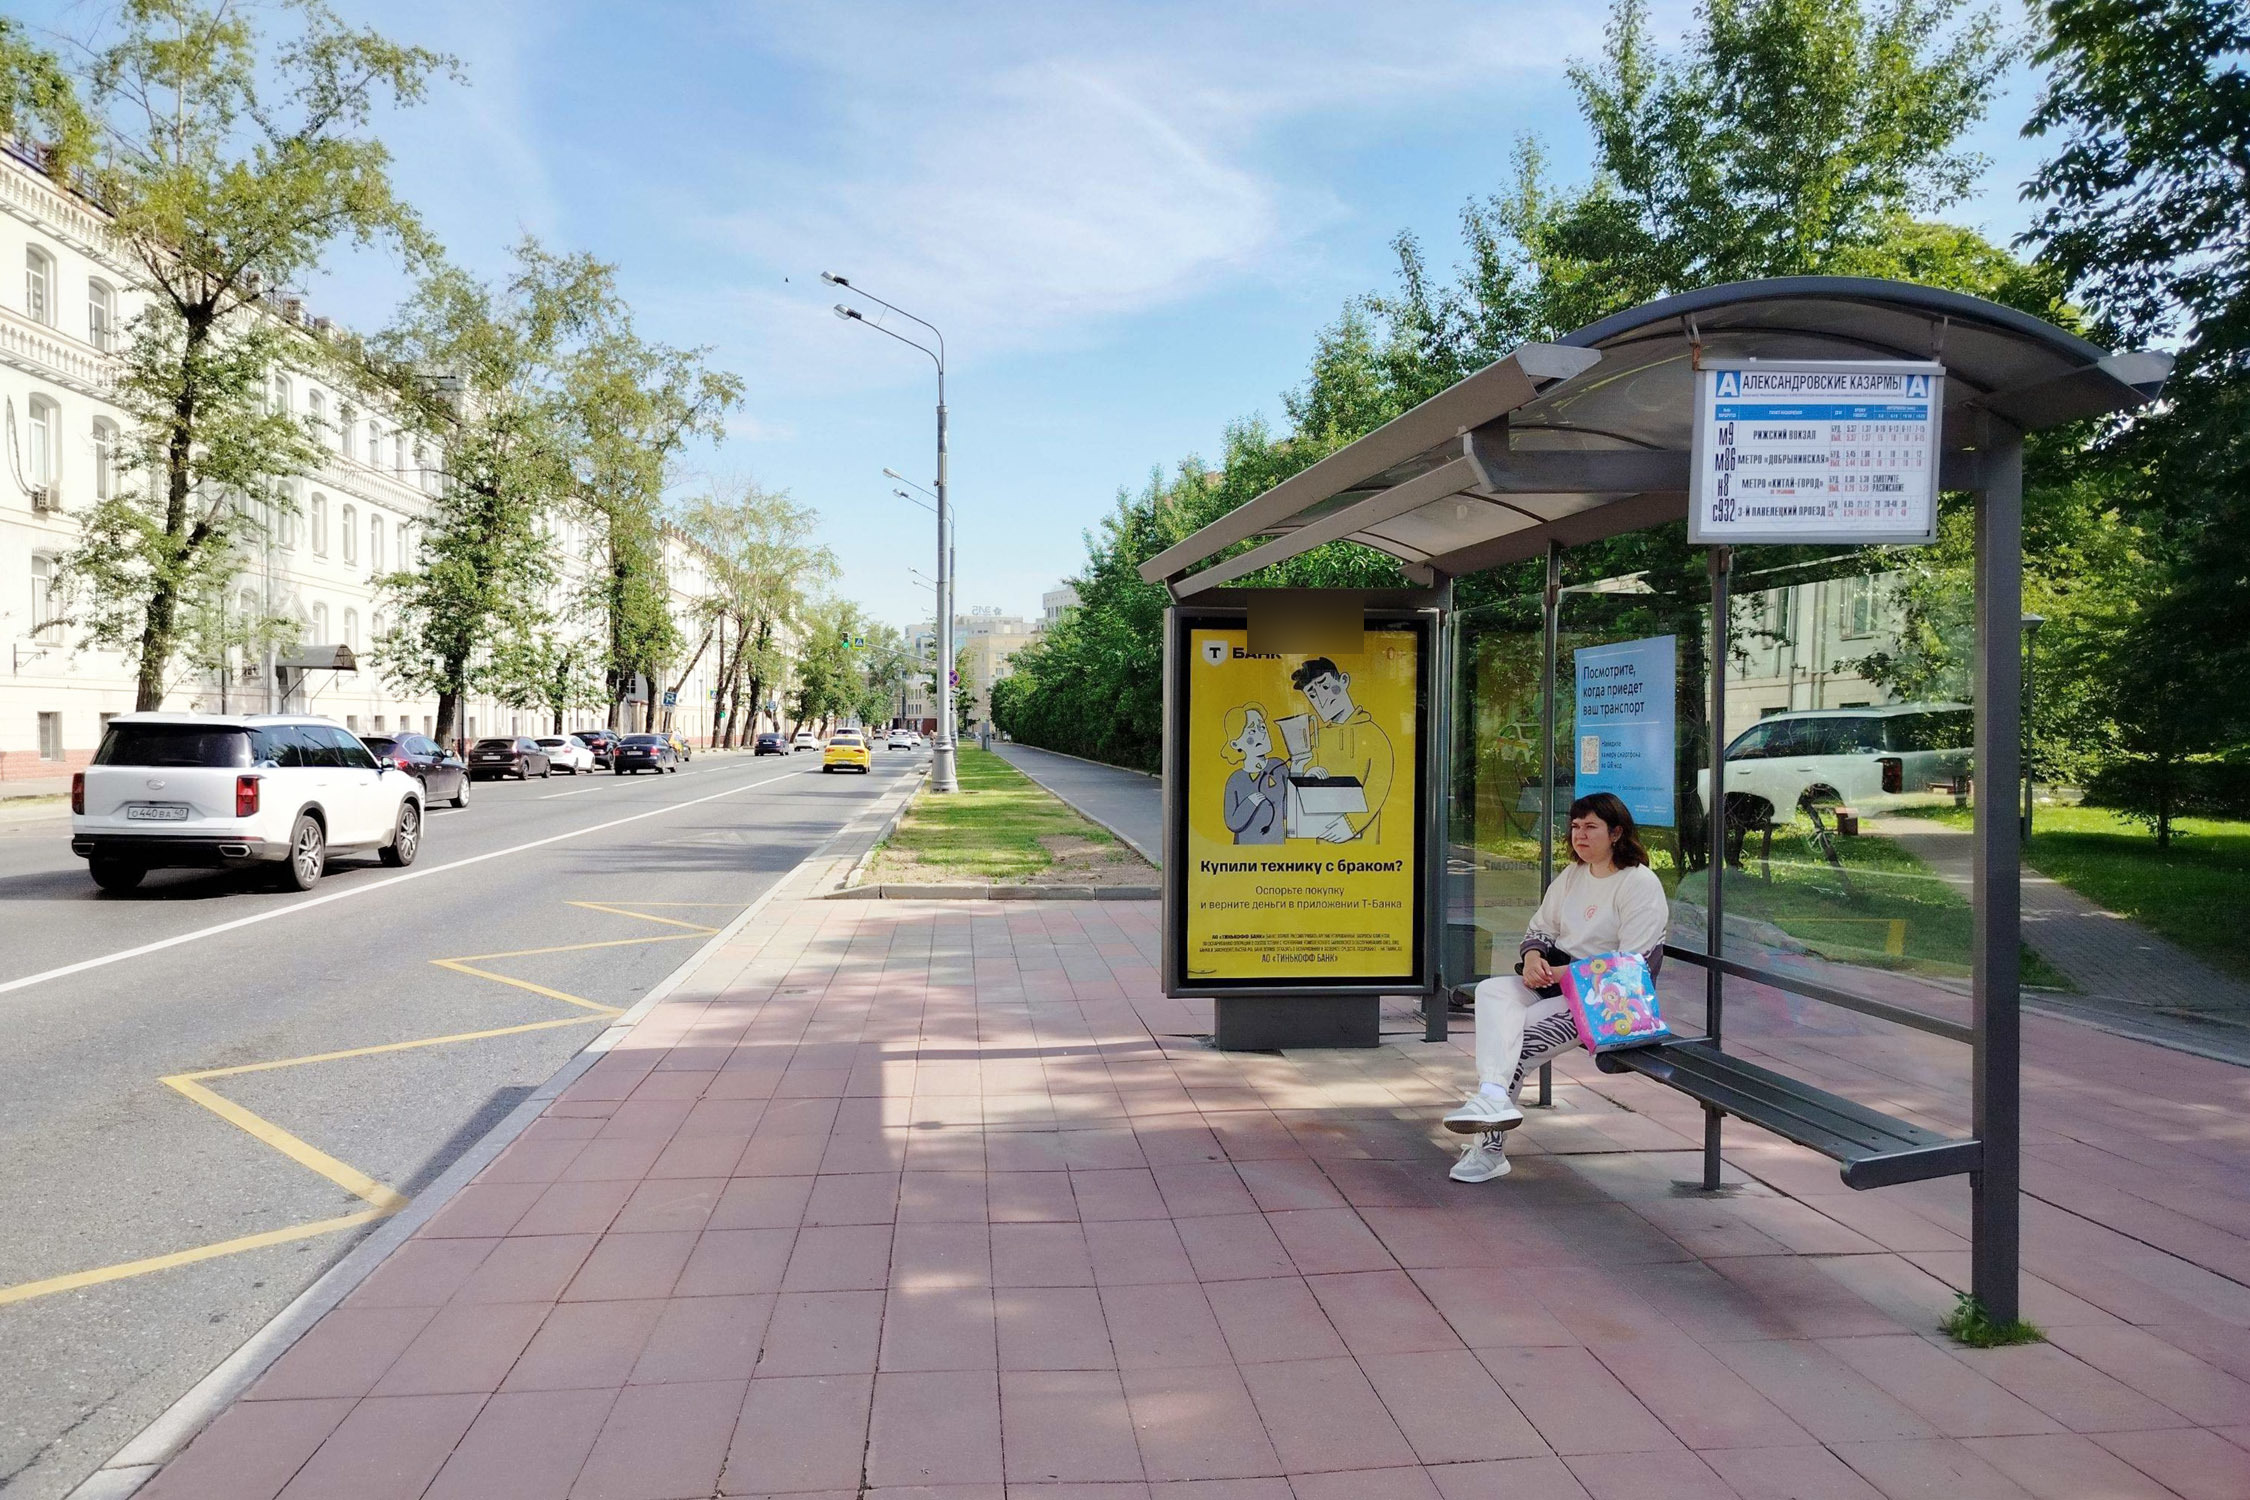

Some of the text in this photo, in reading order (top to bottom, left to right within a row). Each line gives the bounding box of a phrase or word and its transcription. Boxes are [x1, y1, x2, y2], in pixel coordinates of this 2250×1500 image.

[1717, 372, 1738, 396] А
[1742, 376, 1902, 392] АЛЕКСАНДРОВСКИЕ КАЗАРМЫ
[1908, 376, 1928, 397] А
[1753, 429, 1816, 440] РИЖСКИЙ ВОКЗАЛ
[1738, 454, 1762, 464] МЕТРО
[1742, 478, 1824, 489] МЕТРО «КИТАЙ-ГОРОД»
[1872, 474, 1900, 483] СМОТРИТЕ
[1872, 484, 1904, 492] РАСПИСАНИЕ
[1752, 505, 1797, 517] ПАВЕЛЕЦКИЙ
[1799, 506, 1826, 517] ПРОЕЗД
[1210, 648, 1221, 659] Т
[1584, 664, 1636, 680] Посмотрите,
[1584, 682, 1643, 699] когда приедет
[1583, 702, 1645, 718] ваш транспорт
[1201, 859, 1404, 875] Купили технику с браком?
[1256, 886, 1345, 896] Оспорьте покупку
[1210, 902, 1250, 911] верните
[1252, 901, 1286, 910] деньги
[1297, 900, 1359, 910] приложении
[1362, 899, 1402, 909] Т-Банка
[1262, 953, 1338, 963] АО «ТИНЬКОФФ БАНК»
